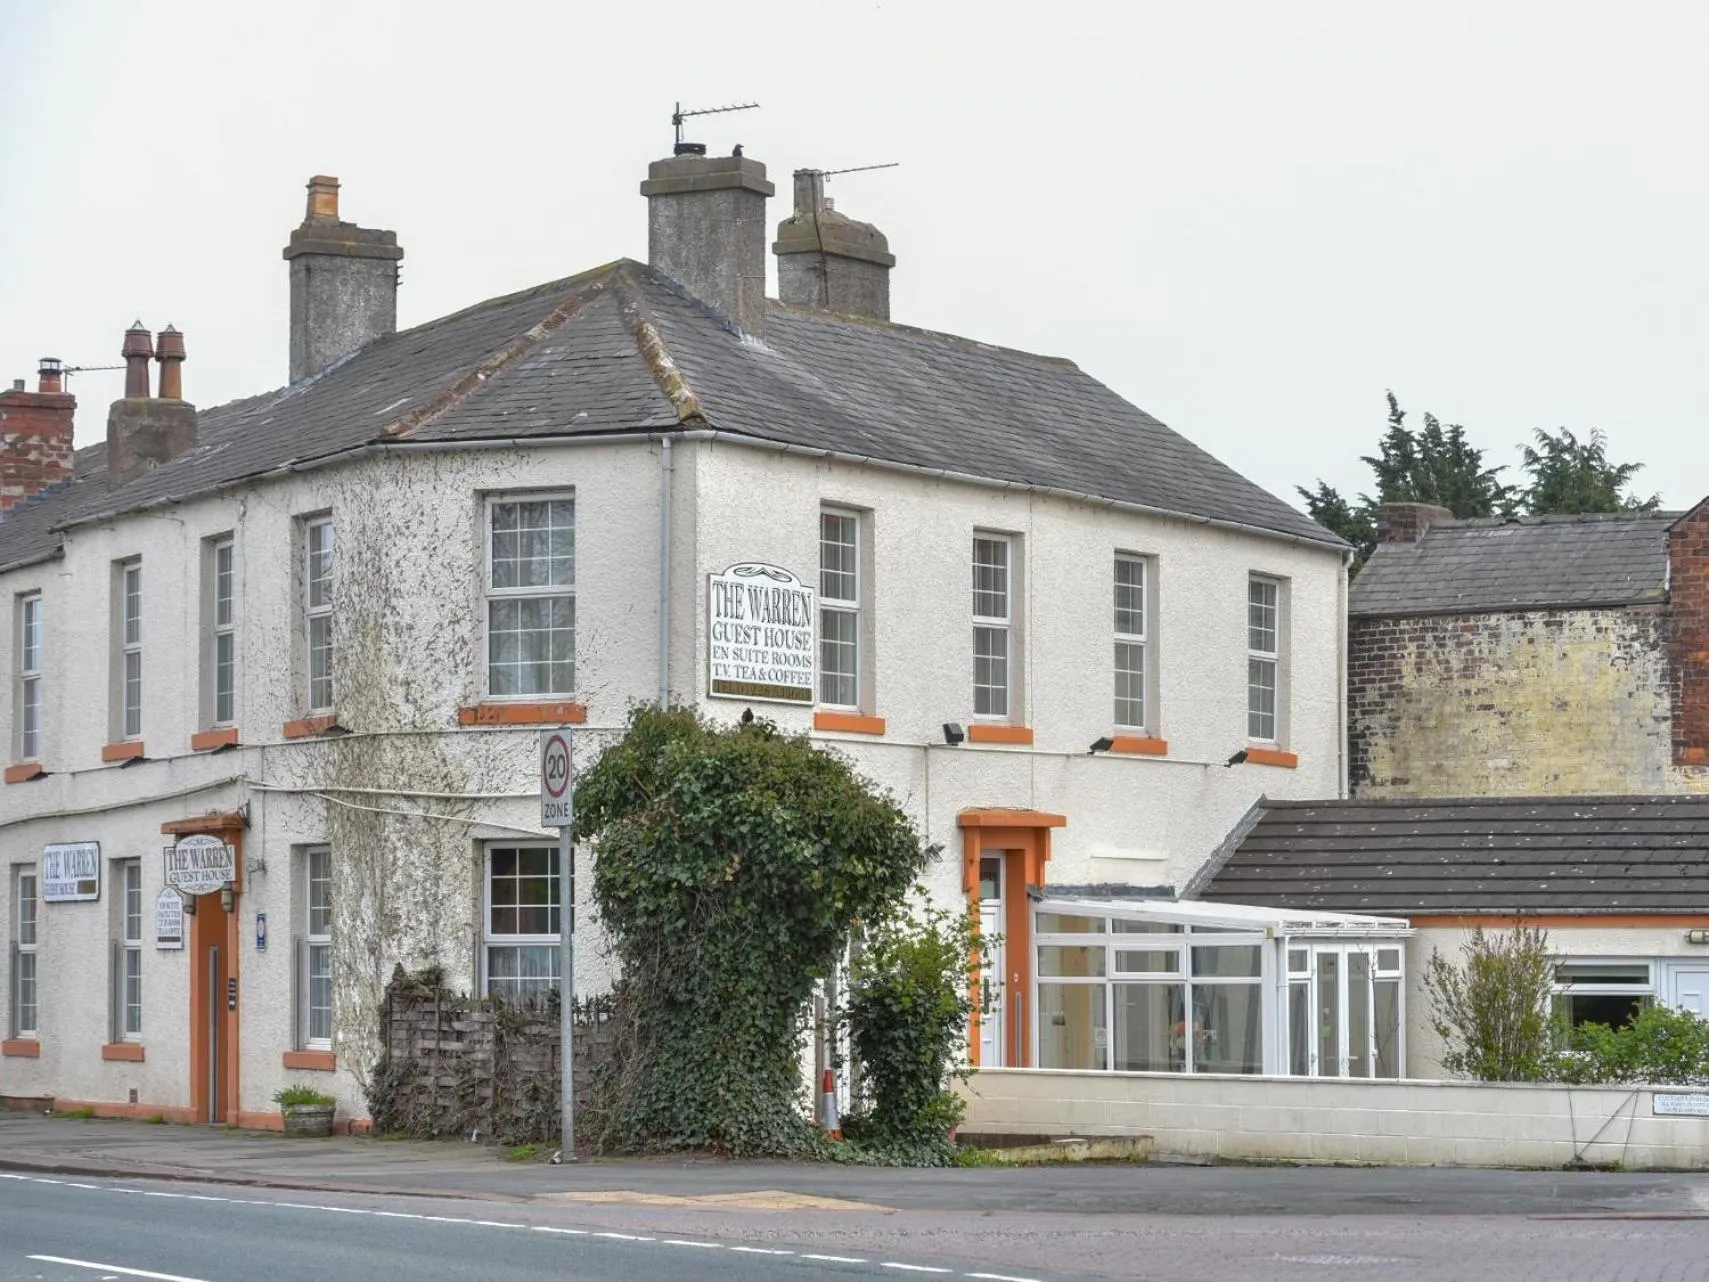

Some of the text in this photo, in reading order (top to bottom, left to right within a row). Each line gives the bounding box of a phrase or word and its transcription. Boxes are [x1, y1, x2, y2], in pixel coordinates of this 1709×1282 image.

[712, 580, 812, 628] THE WARREN
[712, 621, 812, 652] GUEST HOUSE
[712, 645, 812, 668] EN SUITE ROOMS
[548, 754, 566, 779] 20
[544, 803, 569, 819] ZONE
[167, 846, 233, 871] THE WARREN
[169, 868, 232, 884] GUEST HOUSE
